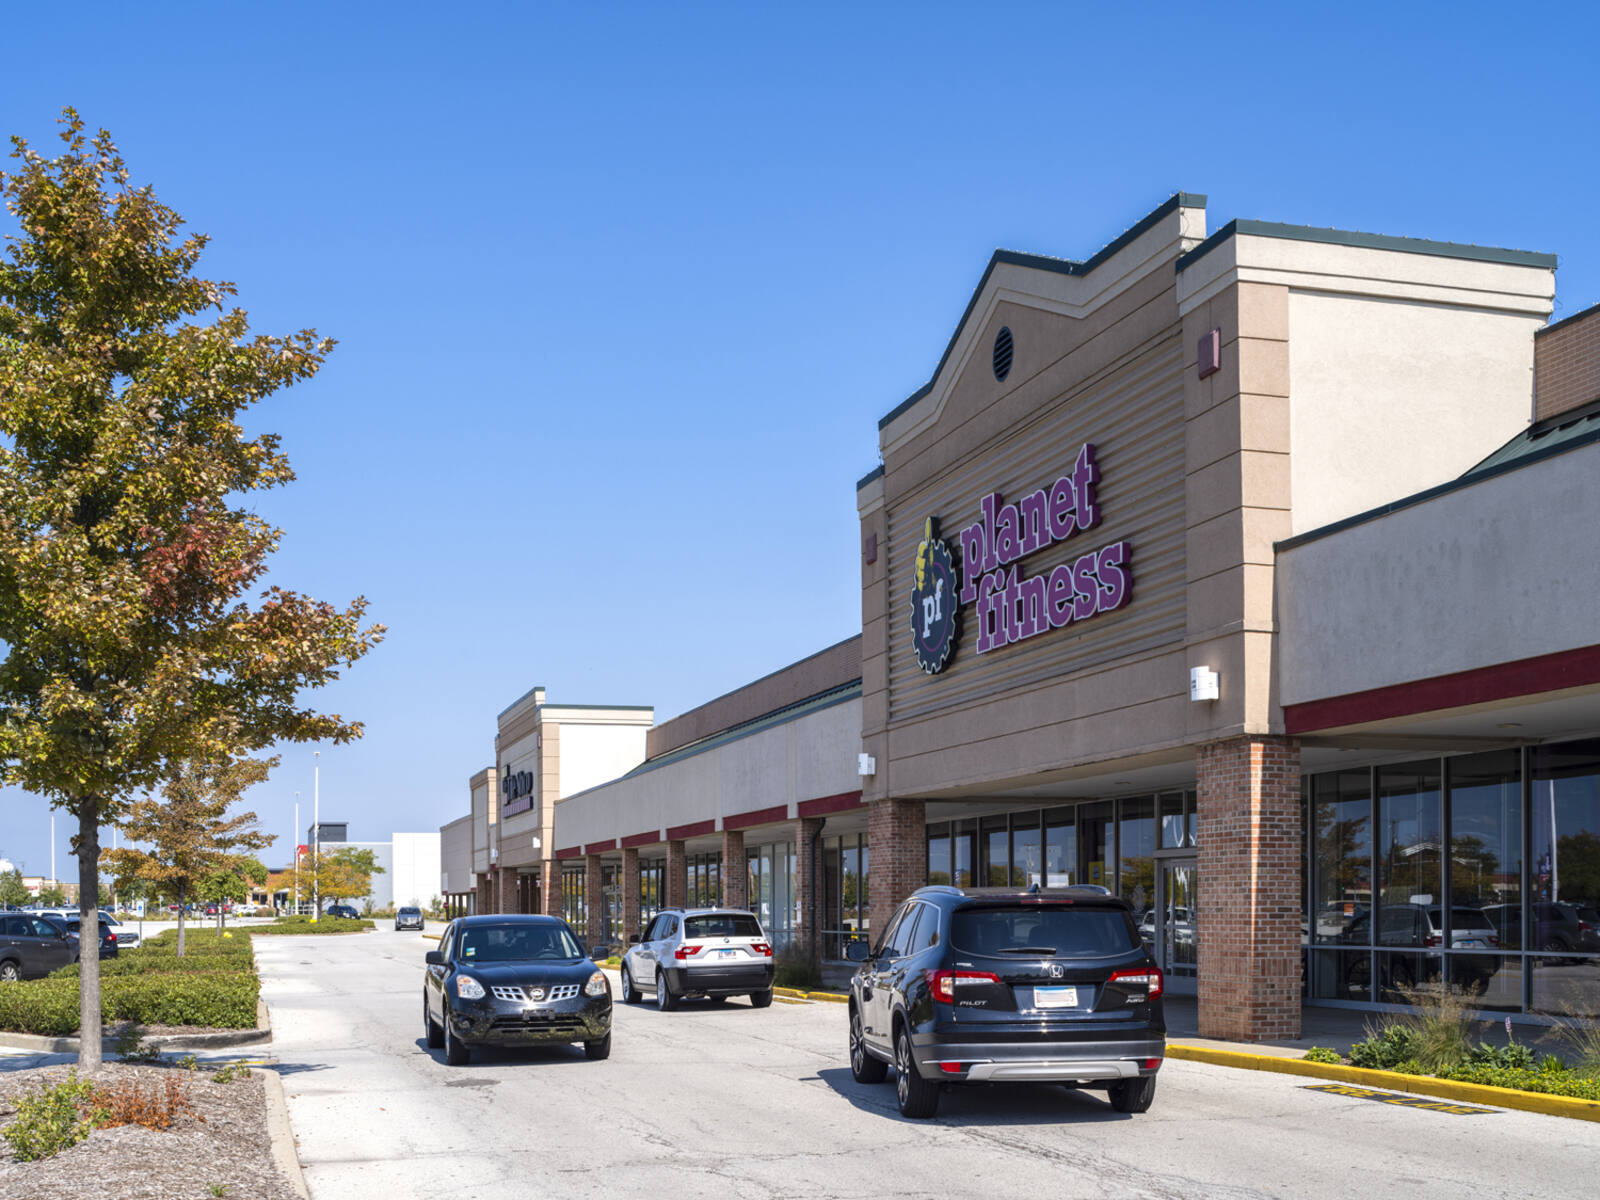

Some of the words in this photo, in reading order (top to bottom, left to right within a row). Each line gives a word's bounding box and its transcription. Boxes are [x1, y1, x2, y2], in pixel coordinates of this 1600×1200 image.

[960, 443, 1100, 605] planet
[922, 577, 944, 639] pf
[976, 541, 1132, 655] fitness
[1303, 1083, 1394, 1098] FIRE
[1383, 1098, 1496, 1115] LANE
